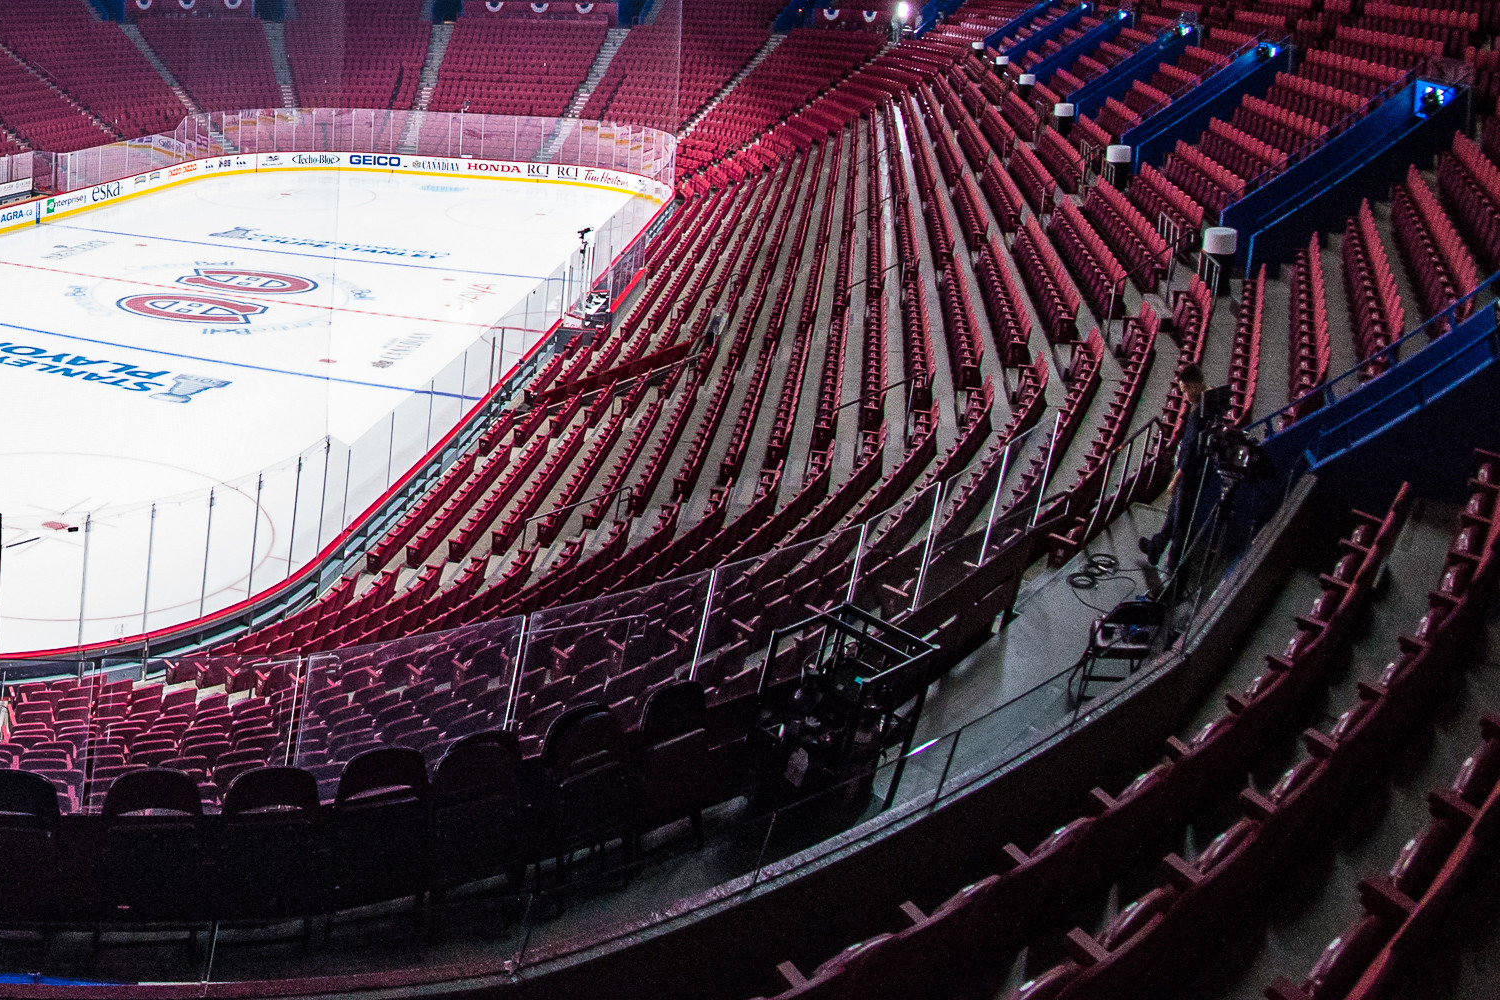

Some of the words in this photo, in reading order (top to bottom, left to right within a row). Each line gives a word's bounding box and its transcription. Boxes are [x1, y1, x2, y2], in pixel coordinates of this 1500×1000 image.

[298, 154, 336, 165] Techo-Bloc
[349, 154, 401, 167] GEICO
[422, 160, 460, 172] CANADIAN
[467, 162, 521, 174] HONDA
[527, 164, 550, 175] RCI
[557, 166, 579, 177] RCI
[584, 169, 599, 183] Tim
[600, 171, 629, 188] Hortons
[49, 195, 84, 212] enterprise
